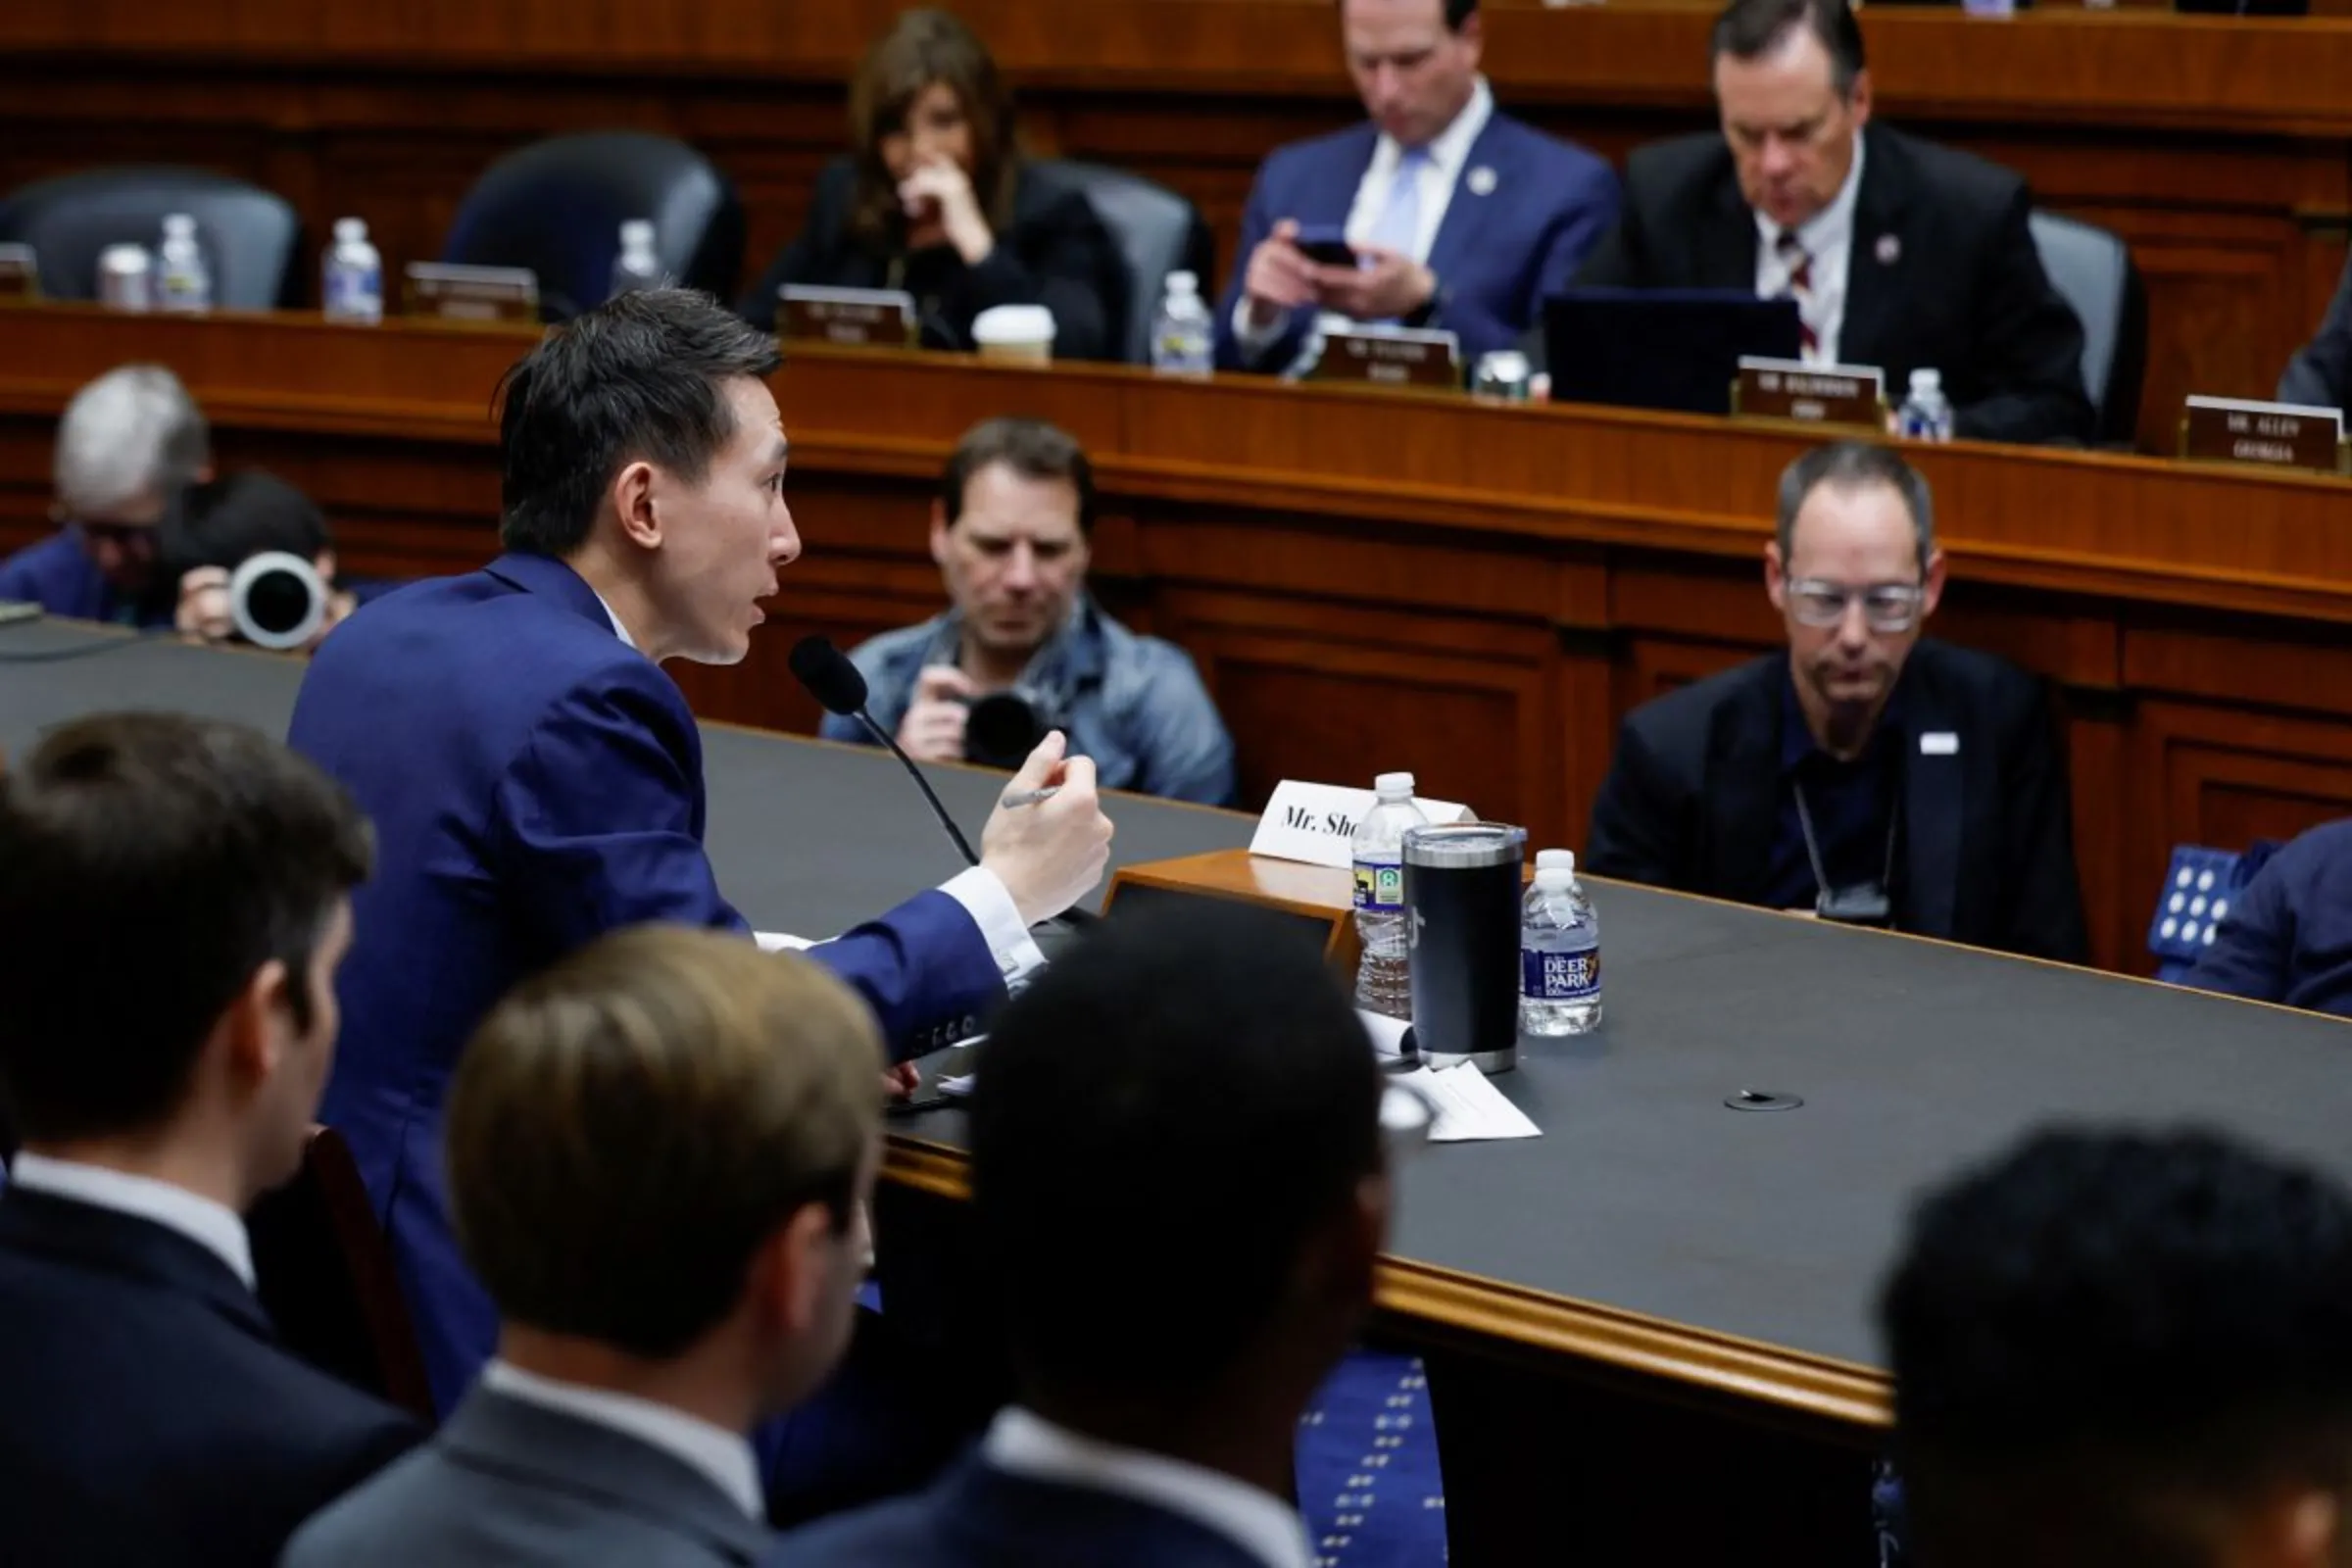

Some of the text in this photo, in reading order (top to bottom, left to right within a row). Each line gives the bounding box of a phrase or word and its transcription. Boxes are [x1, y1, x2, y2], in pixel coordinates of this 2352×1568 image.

[1281, 806, 1315, 831] Mr.
[1544, 957, 1588, 973] DEER
[1545, 972, 1589, 989] PARK
